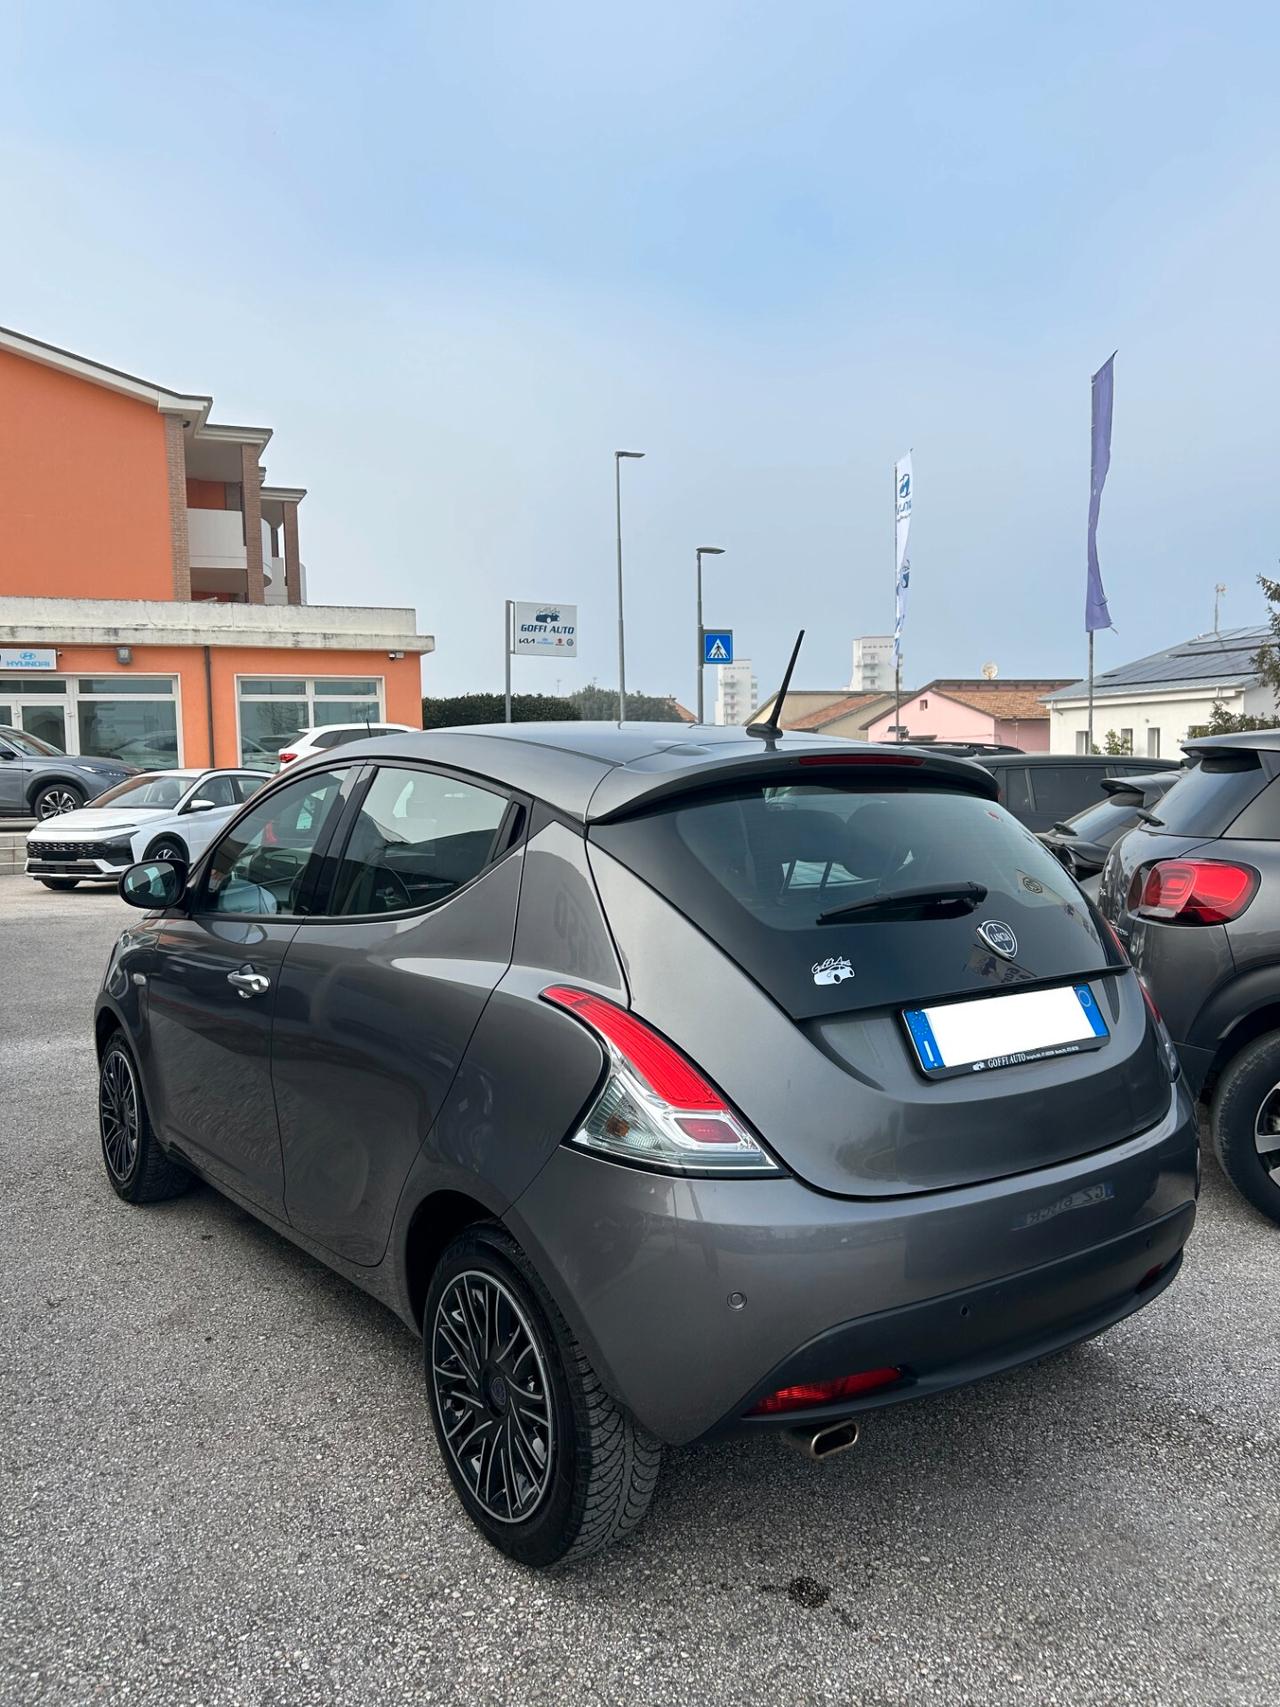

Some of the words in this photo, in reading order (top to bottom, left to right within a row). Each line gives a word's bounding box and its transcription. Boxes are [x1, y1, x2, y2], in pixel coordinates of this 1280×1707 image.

[521, 624, 547, 633] GOFFI
[550, 625, 575, 635] AUTO
[6, 660, 51, 668] HYUNDAI
[987, 1056, 1009, 1069] GOFFI
[1009, 1053, 1026, 1065] AUTO
